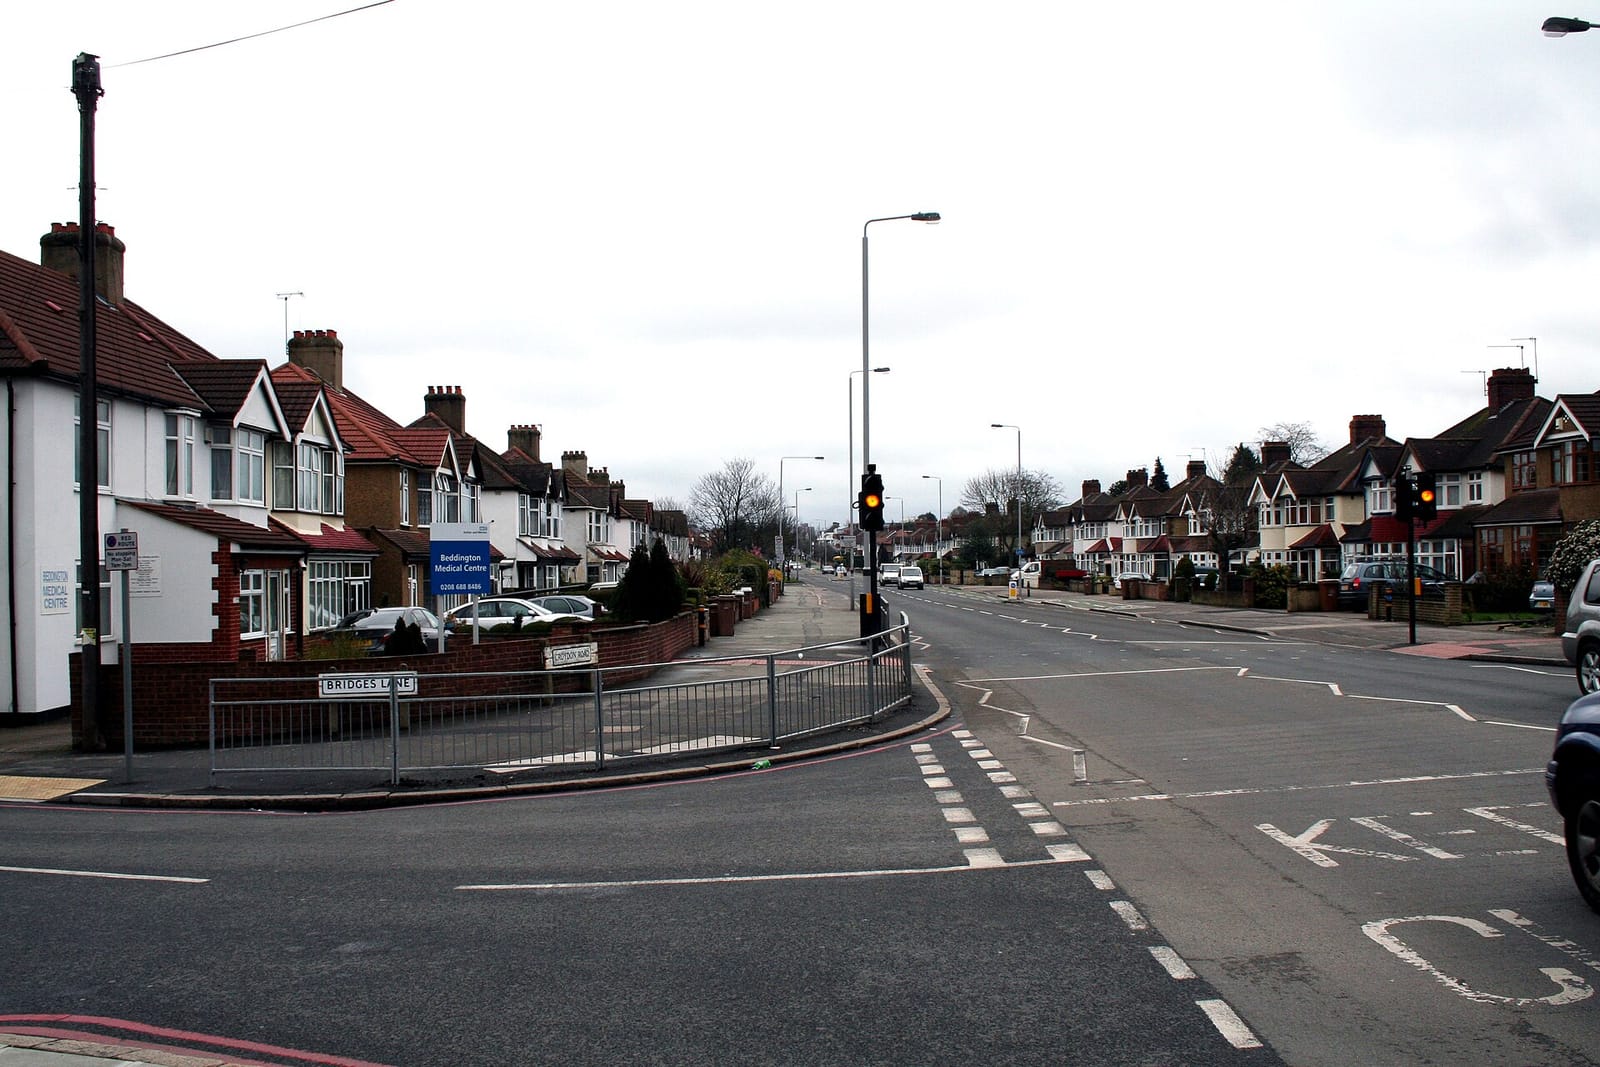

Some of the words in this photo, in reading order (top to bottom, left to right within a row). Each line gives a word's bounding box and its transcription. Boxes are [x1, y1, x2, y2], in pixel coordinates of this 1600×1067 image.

[440, 554, 481, 563] Beddington
[464, 564, 487, 572] Centre
[43, 585, 68, 596] MEDICAL
[44, 598, 67, 609] CENTRE
[327, 679, 377, 690] BRIDGES
